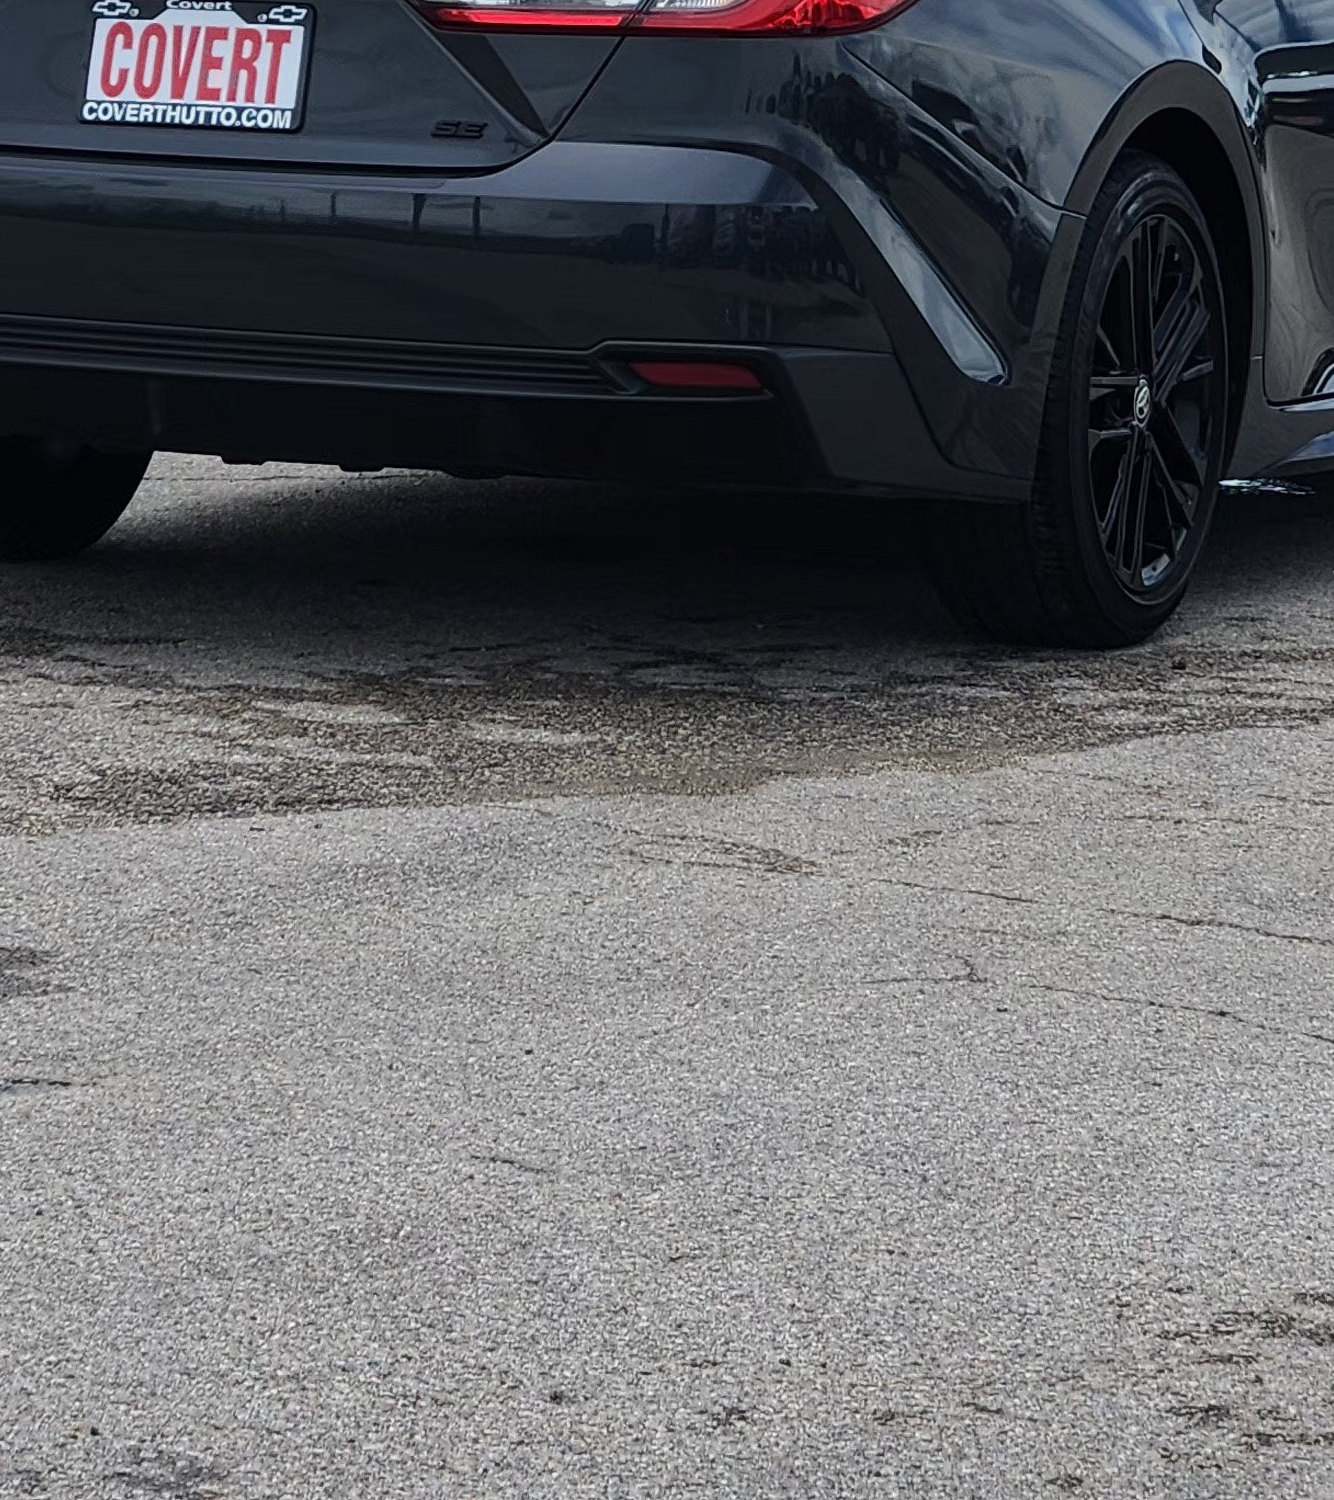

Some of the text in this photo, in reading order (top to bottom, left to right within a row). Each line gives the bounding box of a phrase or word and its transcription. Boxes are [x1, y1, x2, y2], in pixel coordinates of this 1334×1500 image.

[166, 0, 233, 11] Covert
[100, 21, 292, 105] COVERT
[82, 101, 292, 130] COVERTHUTTO.COM
[430, 121, 489, 139] SE
